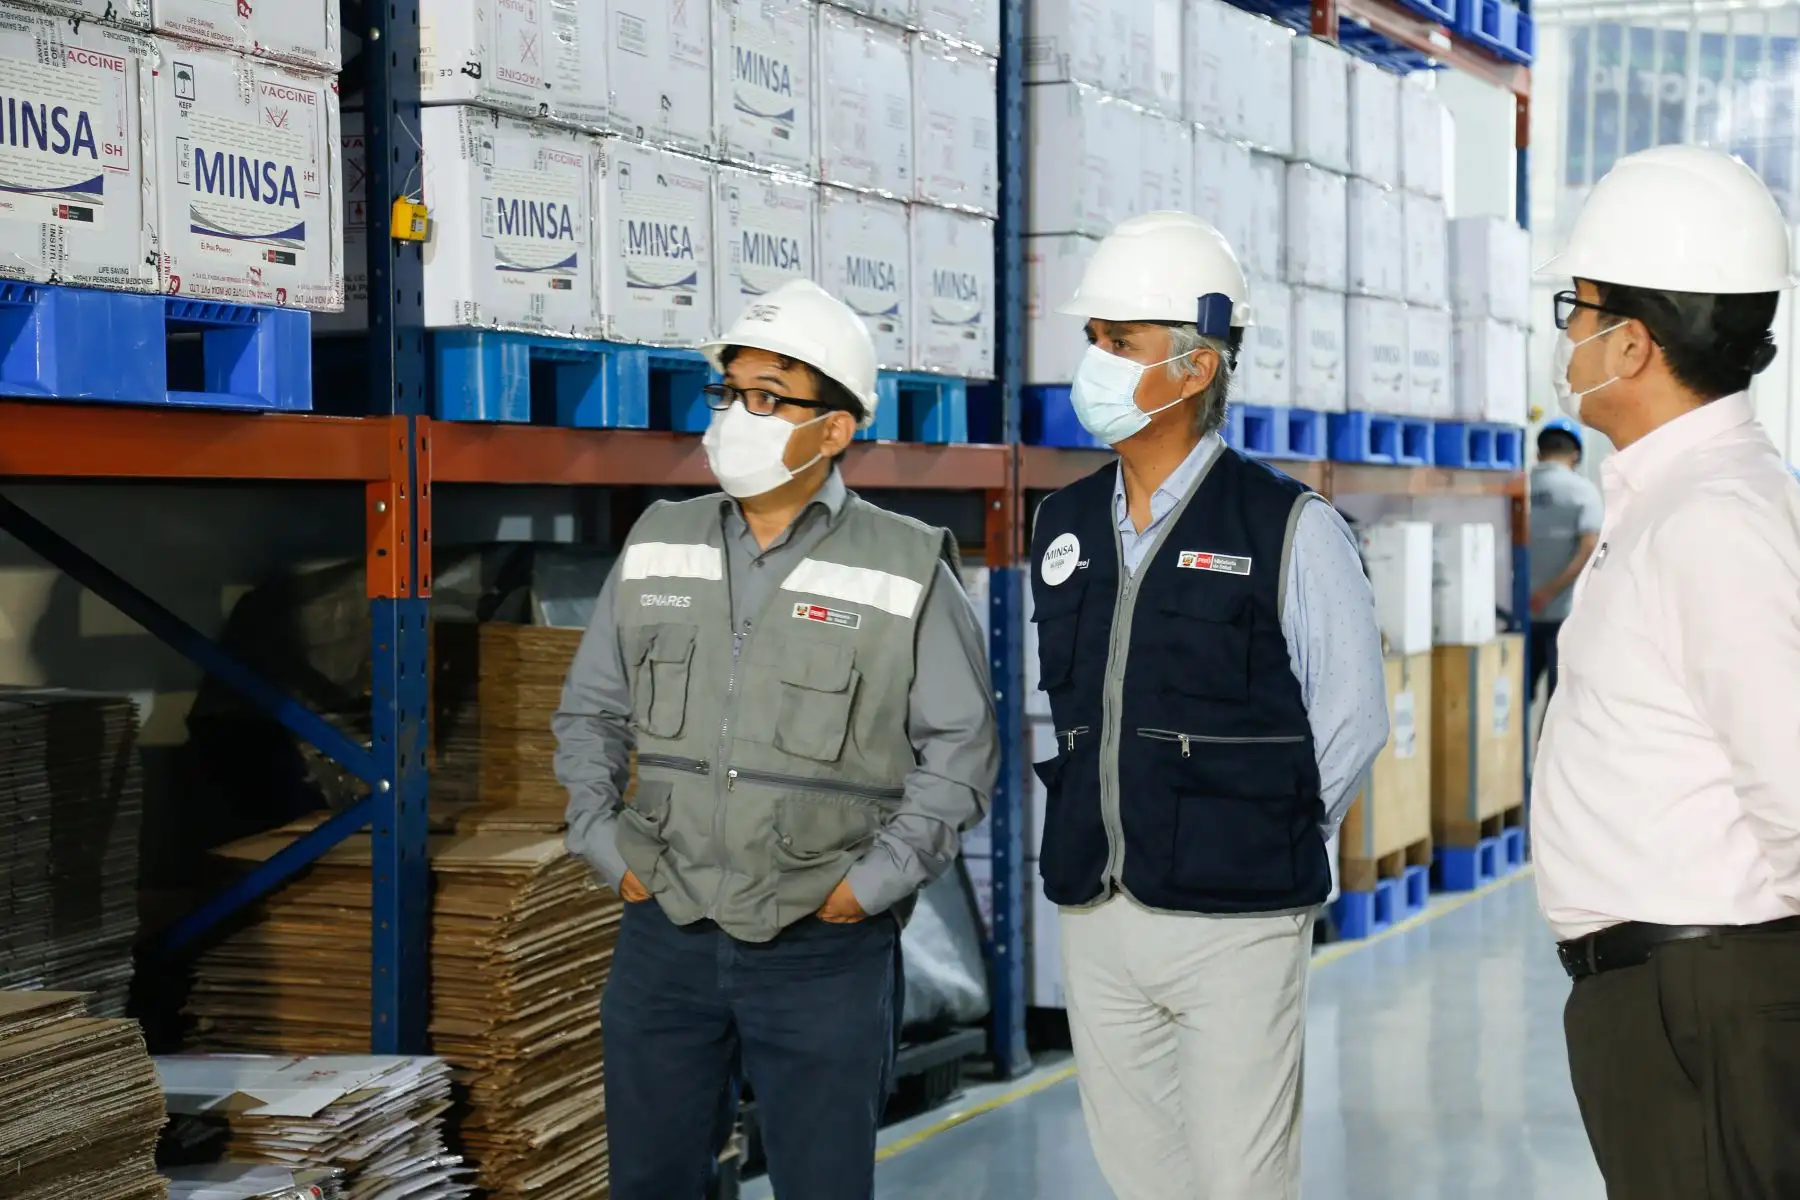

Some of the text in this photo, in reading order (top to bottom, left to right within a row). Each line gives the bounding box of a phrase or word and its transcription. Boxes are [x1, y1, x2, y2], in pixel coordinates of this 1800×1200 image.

[66, 50, 124, 73] ACCINE
[736, 46, 792, 98] MINSA
[499, 67, 541, 86] VACCINE
[260, 85, 316, 106] VACCINE
[102, 141, 123, 156] SH
[341, 139, 364, 149] VA
[194, 147, 301, 209] MINSA
[498, 197, 574, 241] MINSA
[628, 220, 694, 260] MINSA
[742, 229, 801, 272] MINSA
[92, 275, 125, 285] PERISHABLE
[98, 266, 130, 275] LIFE SAVING
[846, 255, 896, 293] MINSA
[933, 268, 978, 301] MINSA
[1045, 543, 1074, 560] MINSA
[640, 594, 692, 608] CENARES
